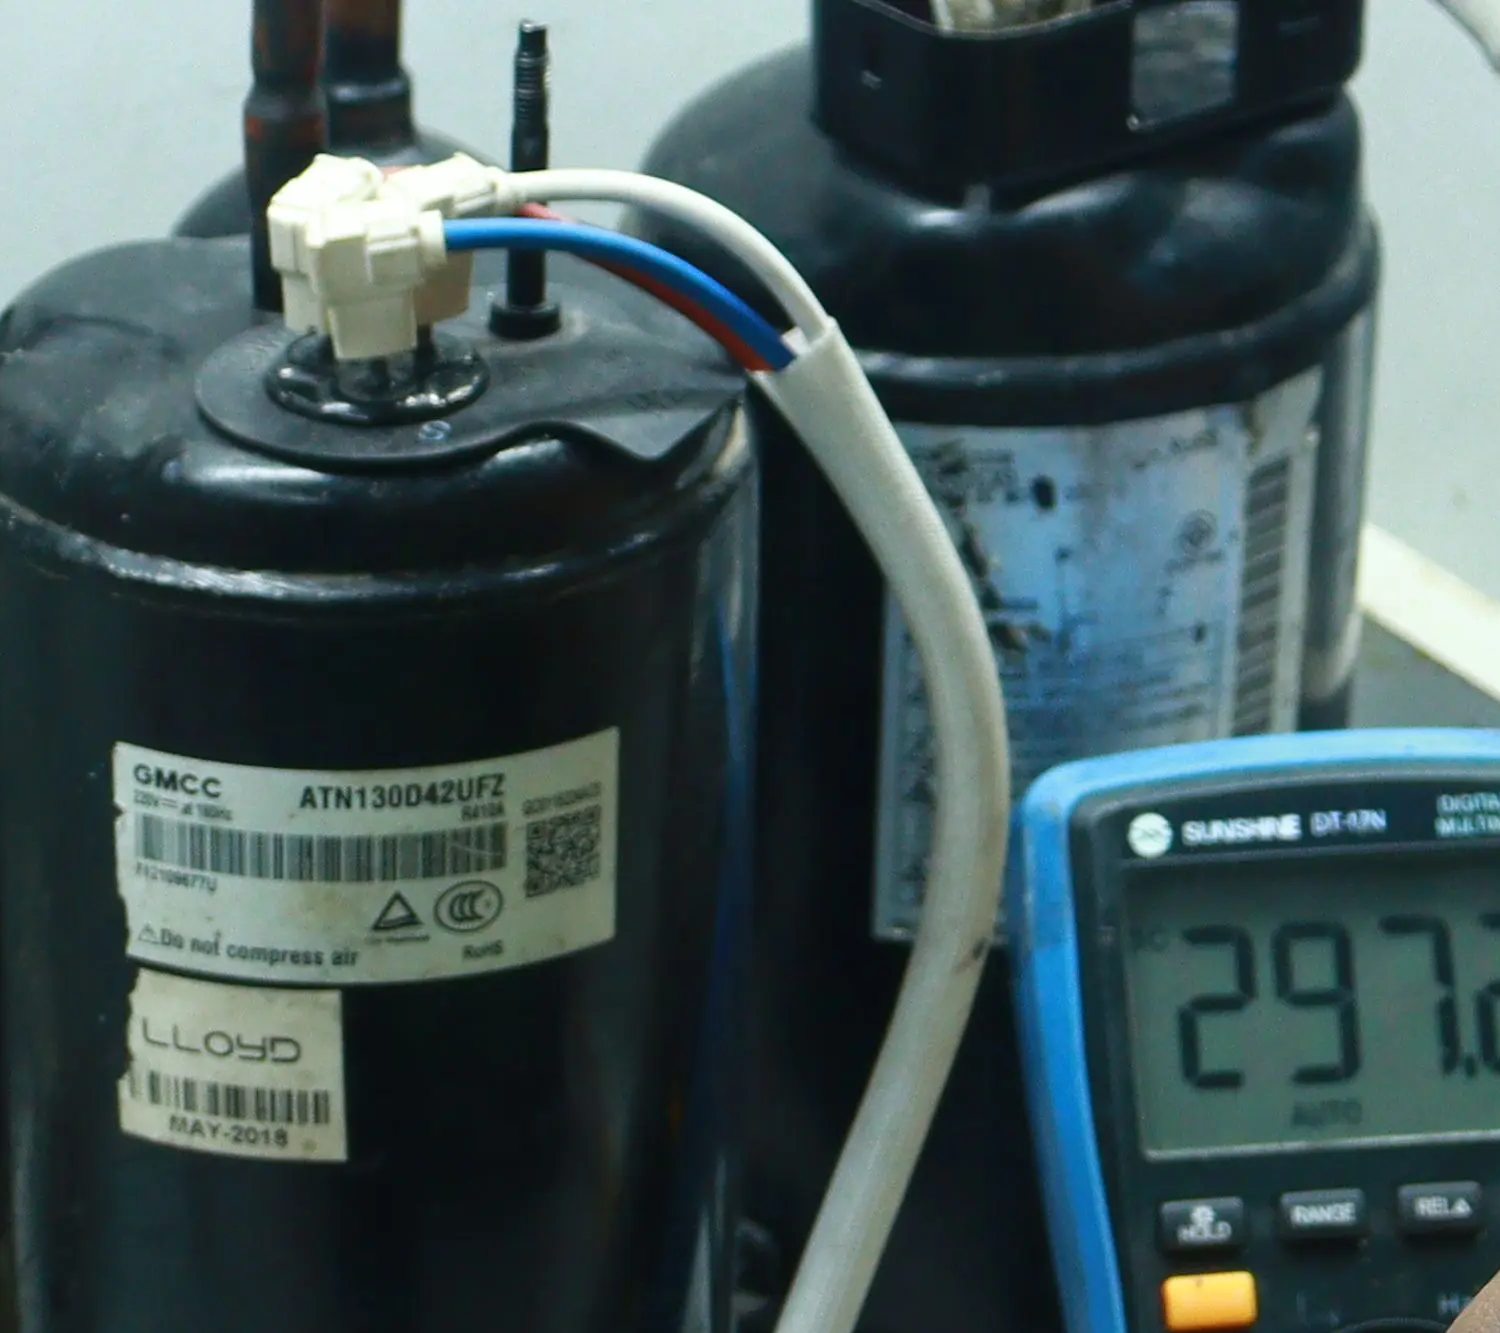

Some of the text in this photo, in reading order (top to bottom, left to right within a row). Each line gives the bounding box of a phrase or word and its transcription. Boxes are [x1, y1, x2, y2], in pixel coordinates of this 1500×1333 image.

[133, 763, 222, 798] GMCC
[1182, 813, 1302, 846] SUNSHINE
[160, 928, 359, 967] Do not compress air
[141, 1016, 302, 1064] LLOYD
[169, 1115, 289, 1148] MAY-2018
[1291, 1201, 1357, 1227] RANGE
